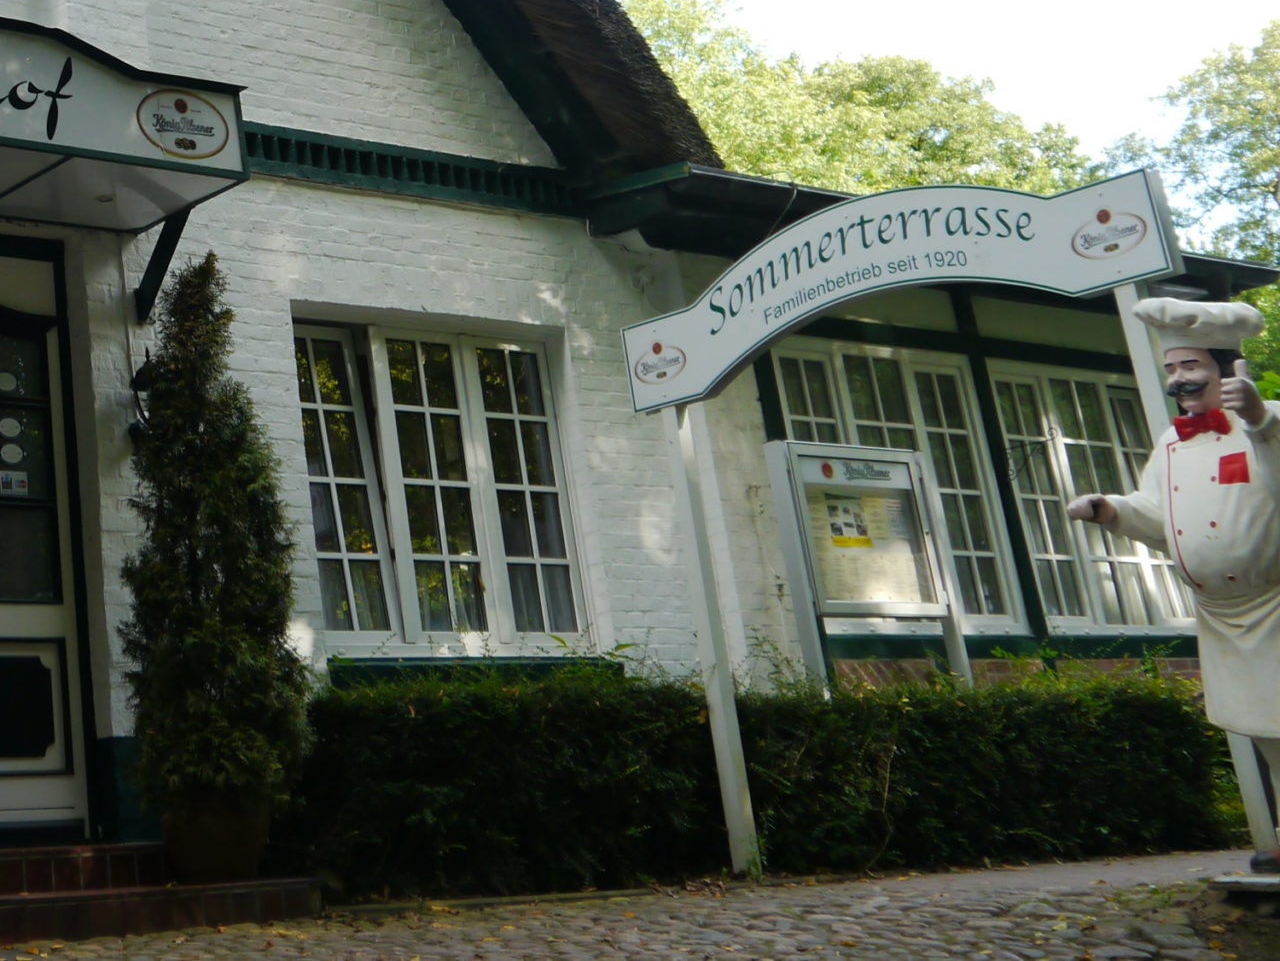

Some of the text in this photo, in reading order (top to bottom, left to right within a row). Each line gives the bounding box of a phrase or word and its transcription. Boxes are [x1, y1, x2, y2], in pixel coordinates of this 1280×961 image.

[709, 205, 1036, 336] Sommerterrasse
[763, 250, 968, 325] Familienbetrieb seit 1920
